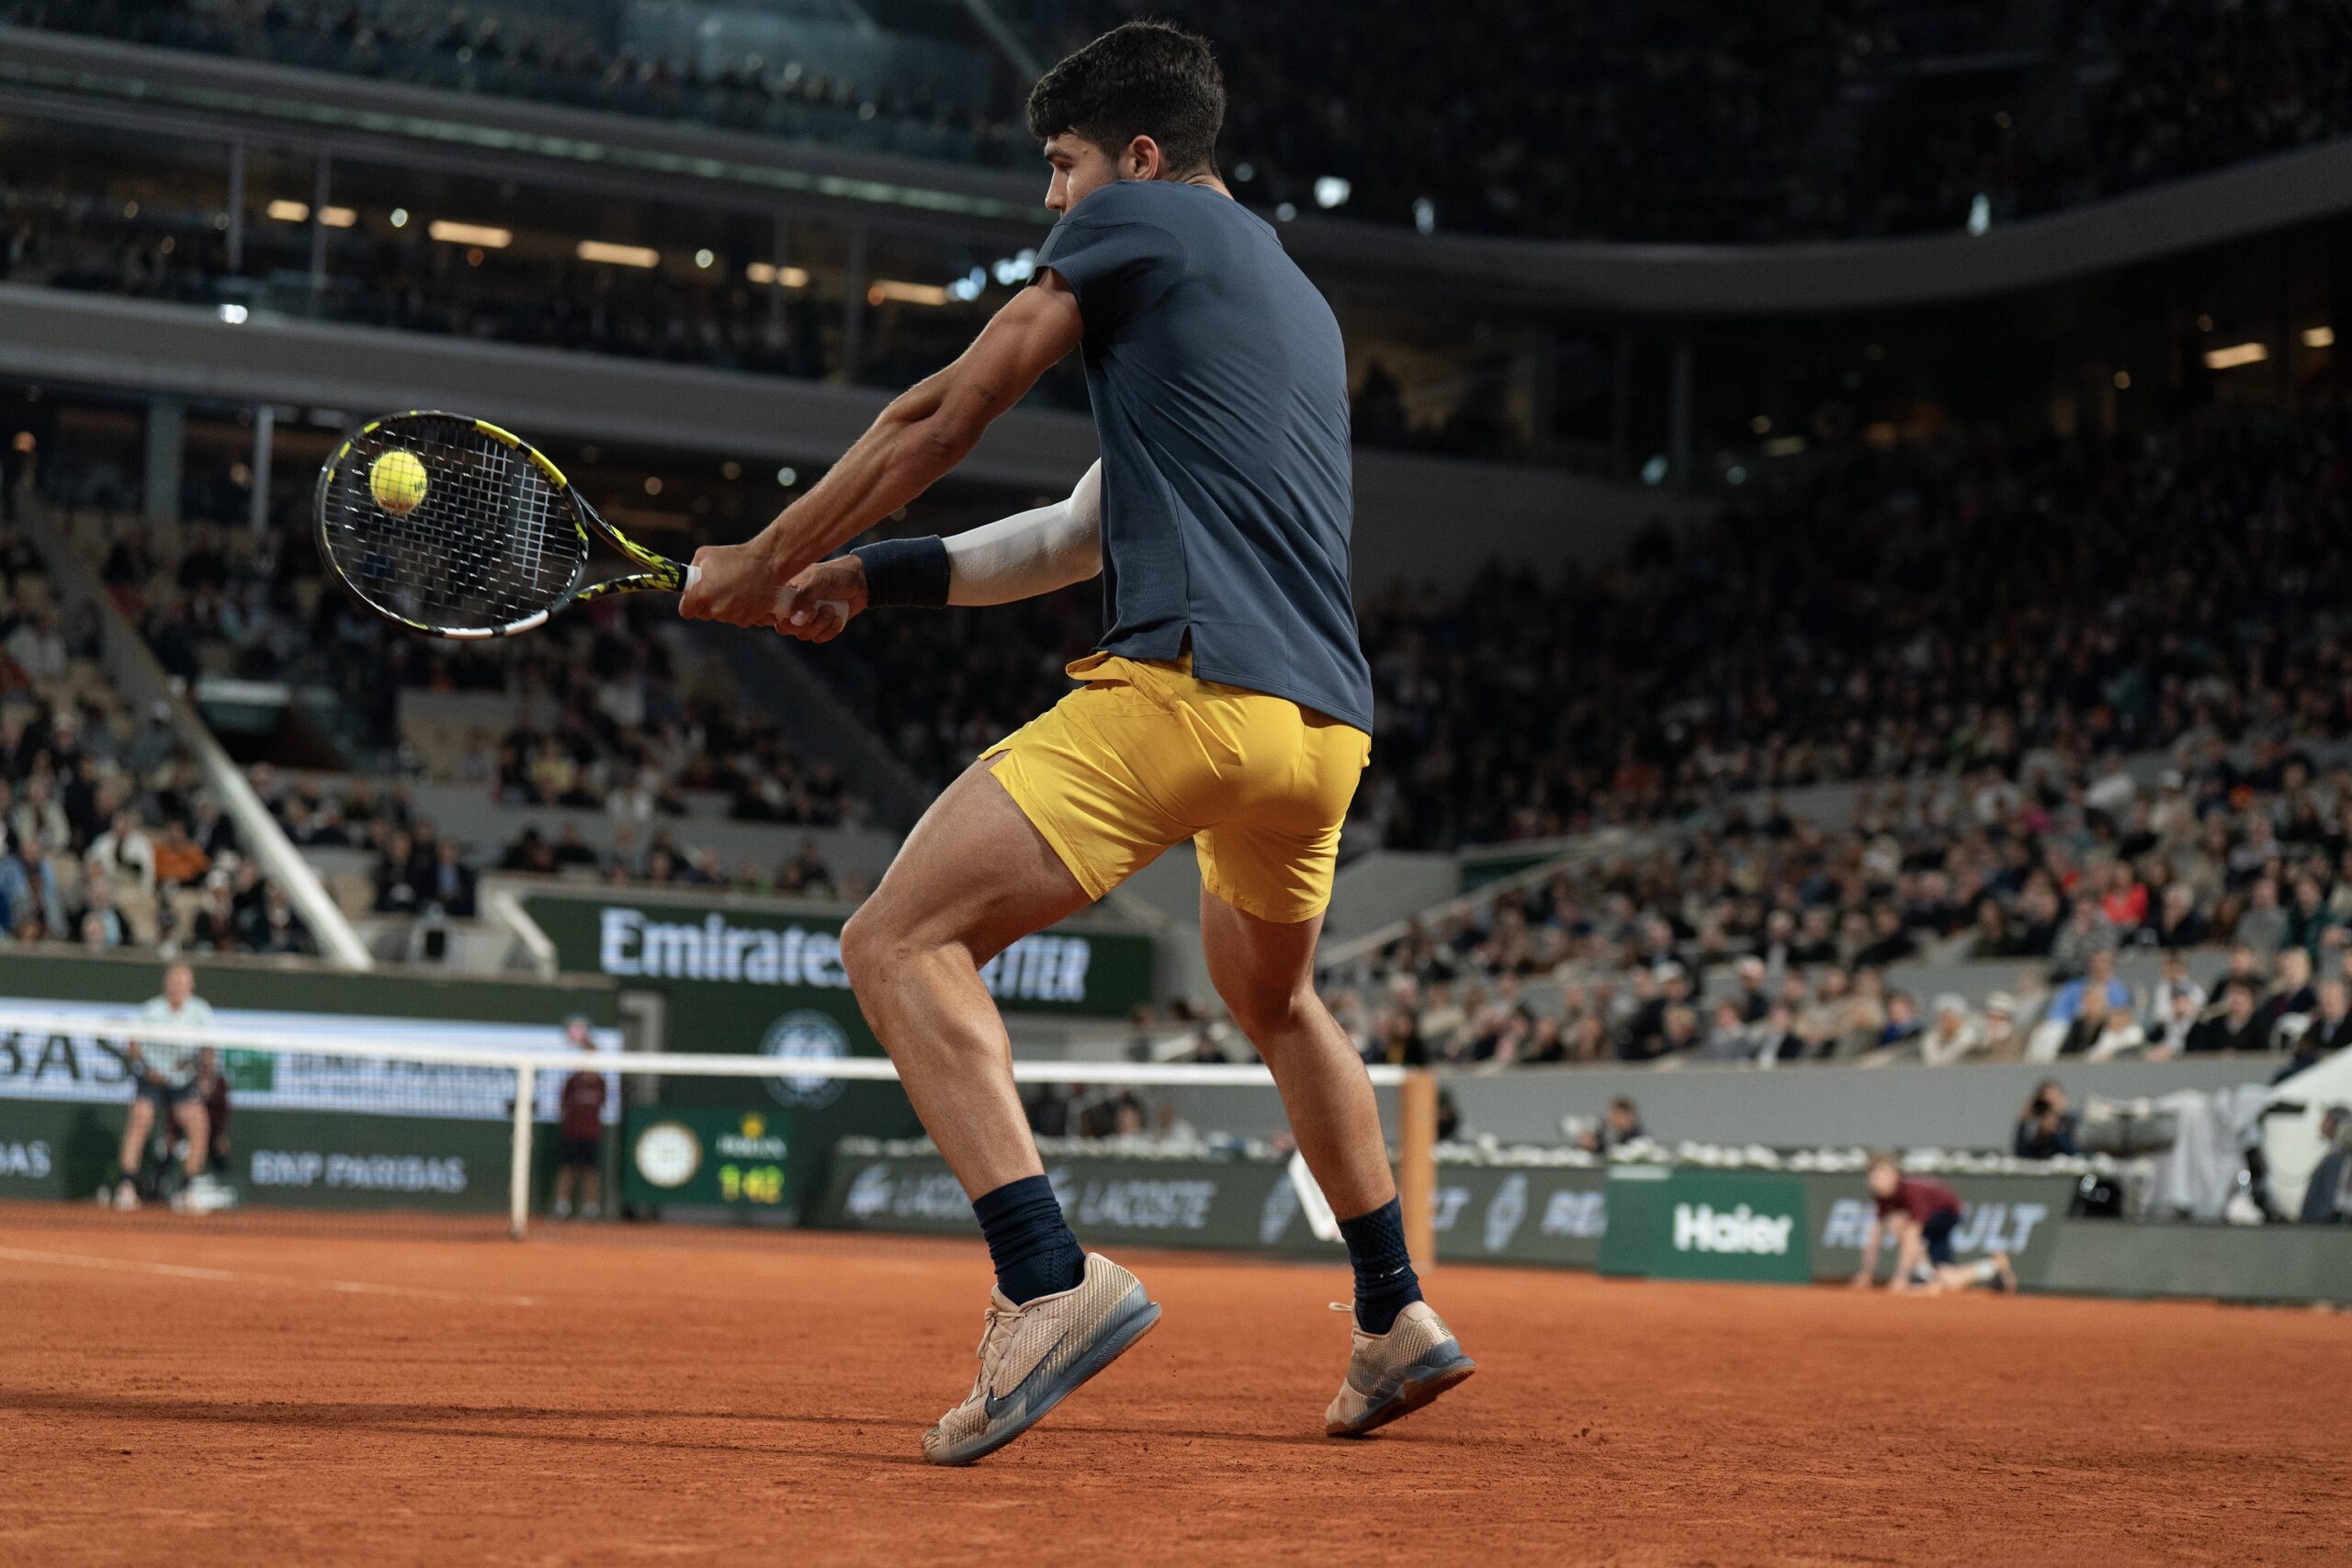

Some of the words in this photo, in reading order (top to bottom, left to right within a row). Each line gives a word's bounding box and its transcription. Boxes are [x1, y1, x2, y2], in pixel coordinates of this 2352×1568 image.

[601, 908, 851, 989] Emirate
[978, 933, 1091, 1003] ETTER
[1672, 1202, 1794, 1255] Haier
